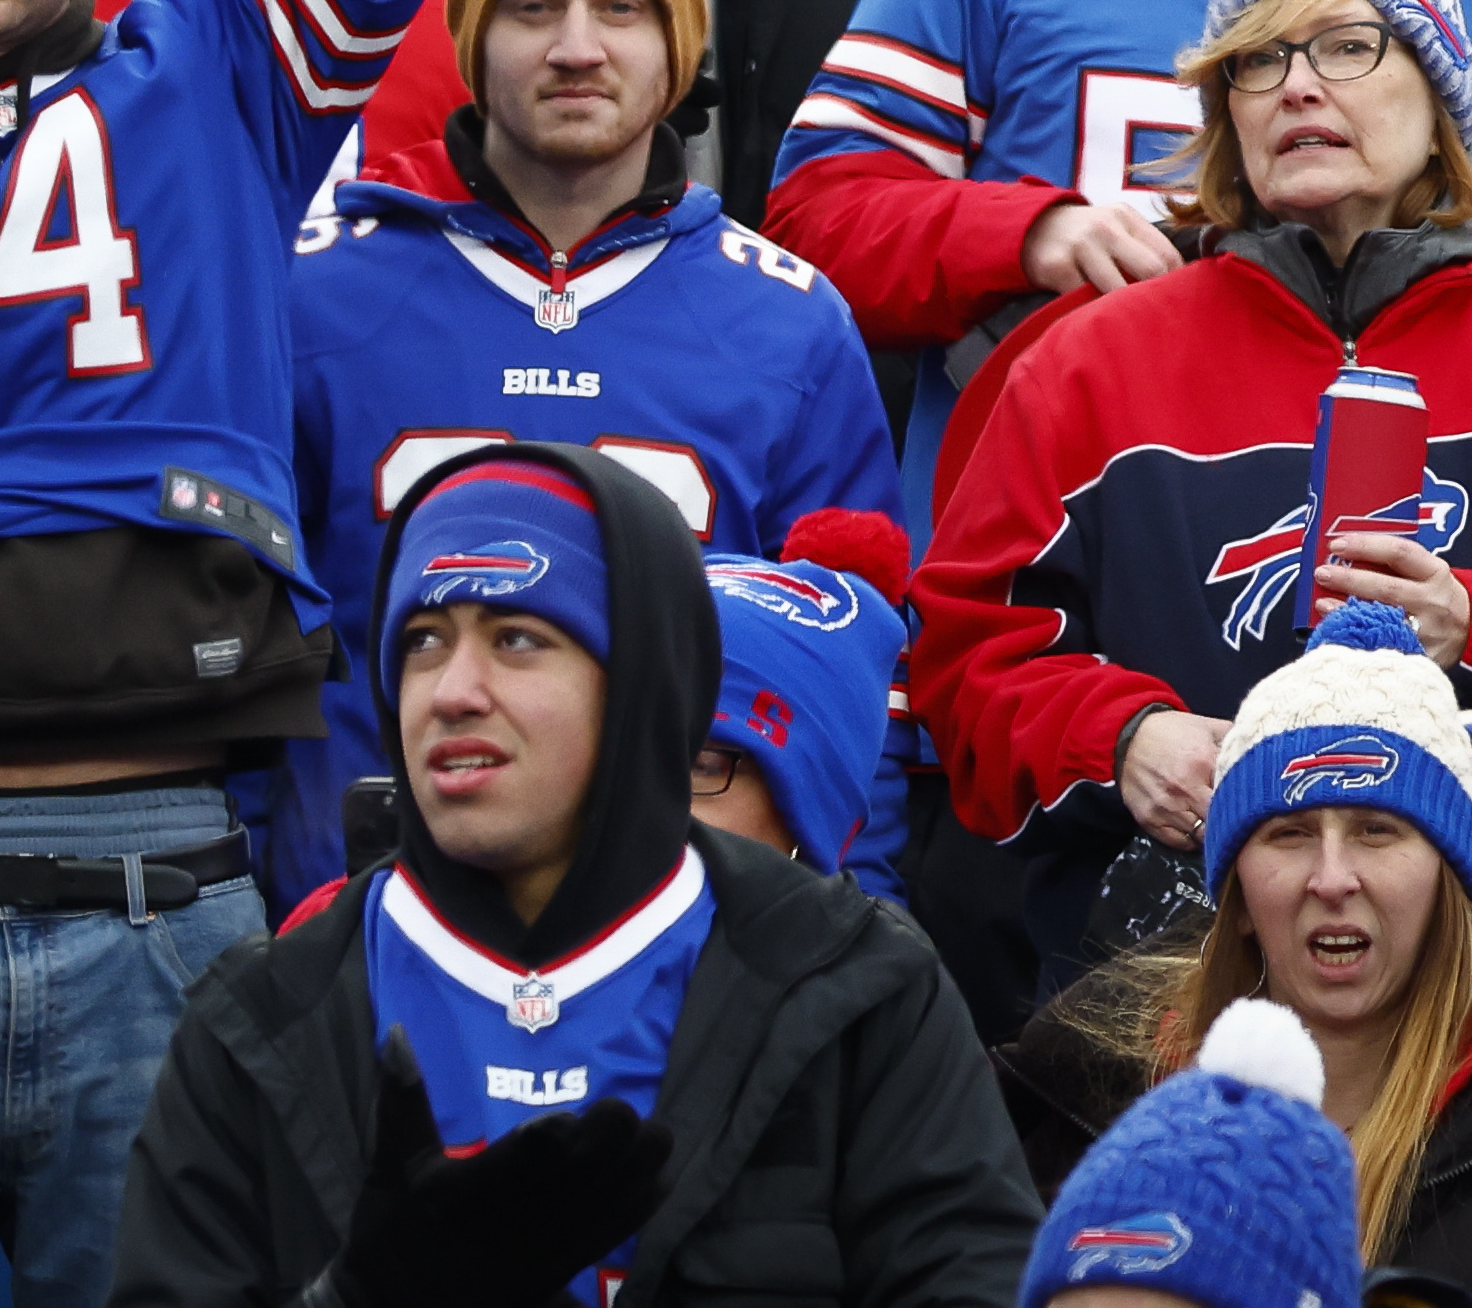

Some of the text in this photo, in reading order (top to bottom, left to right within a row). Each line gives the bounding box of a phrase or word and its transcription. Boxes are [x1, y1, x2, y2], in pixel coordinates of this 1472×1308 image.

[538, 299, 576, 323] NFL
[502, 367, 601, 398] BILLS
[485, 1064, 590, 1106] BILLS
